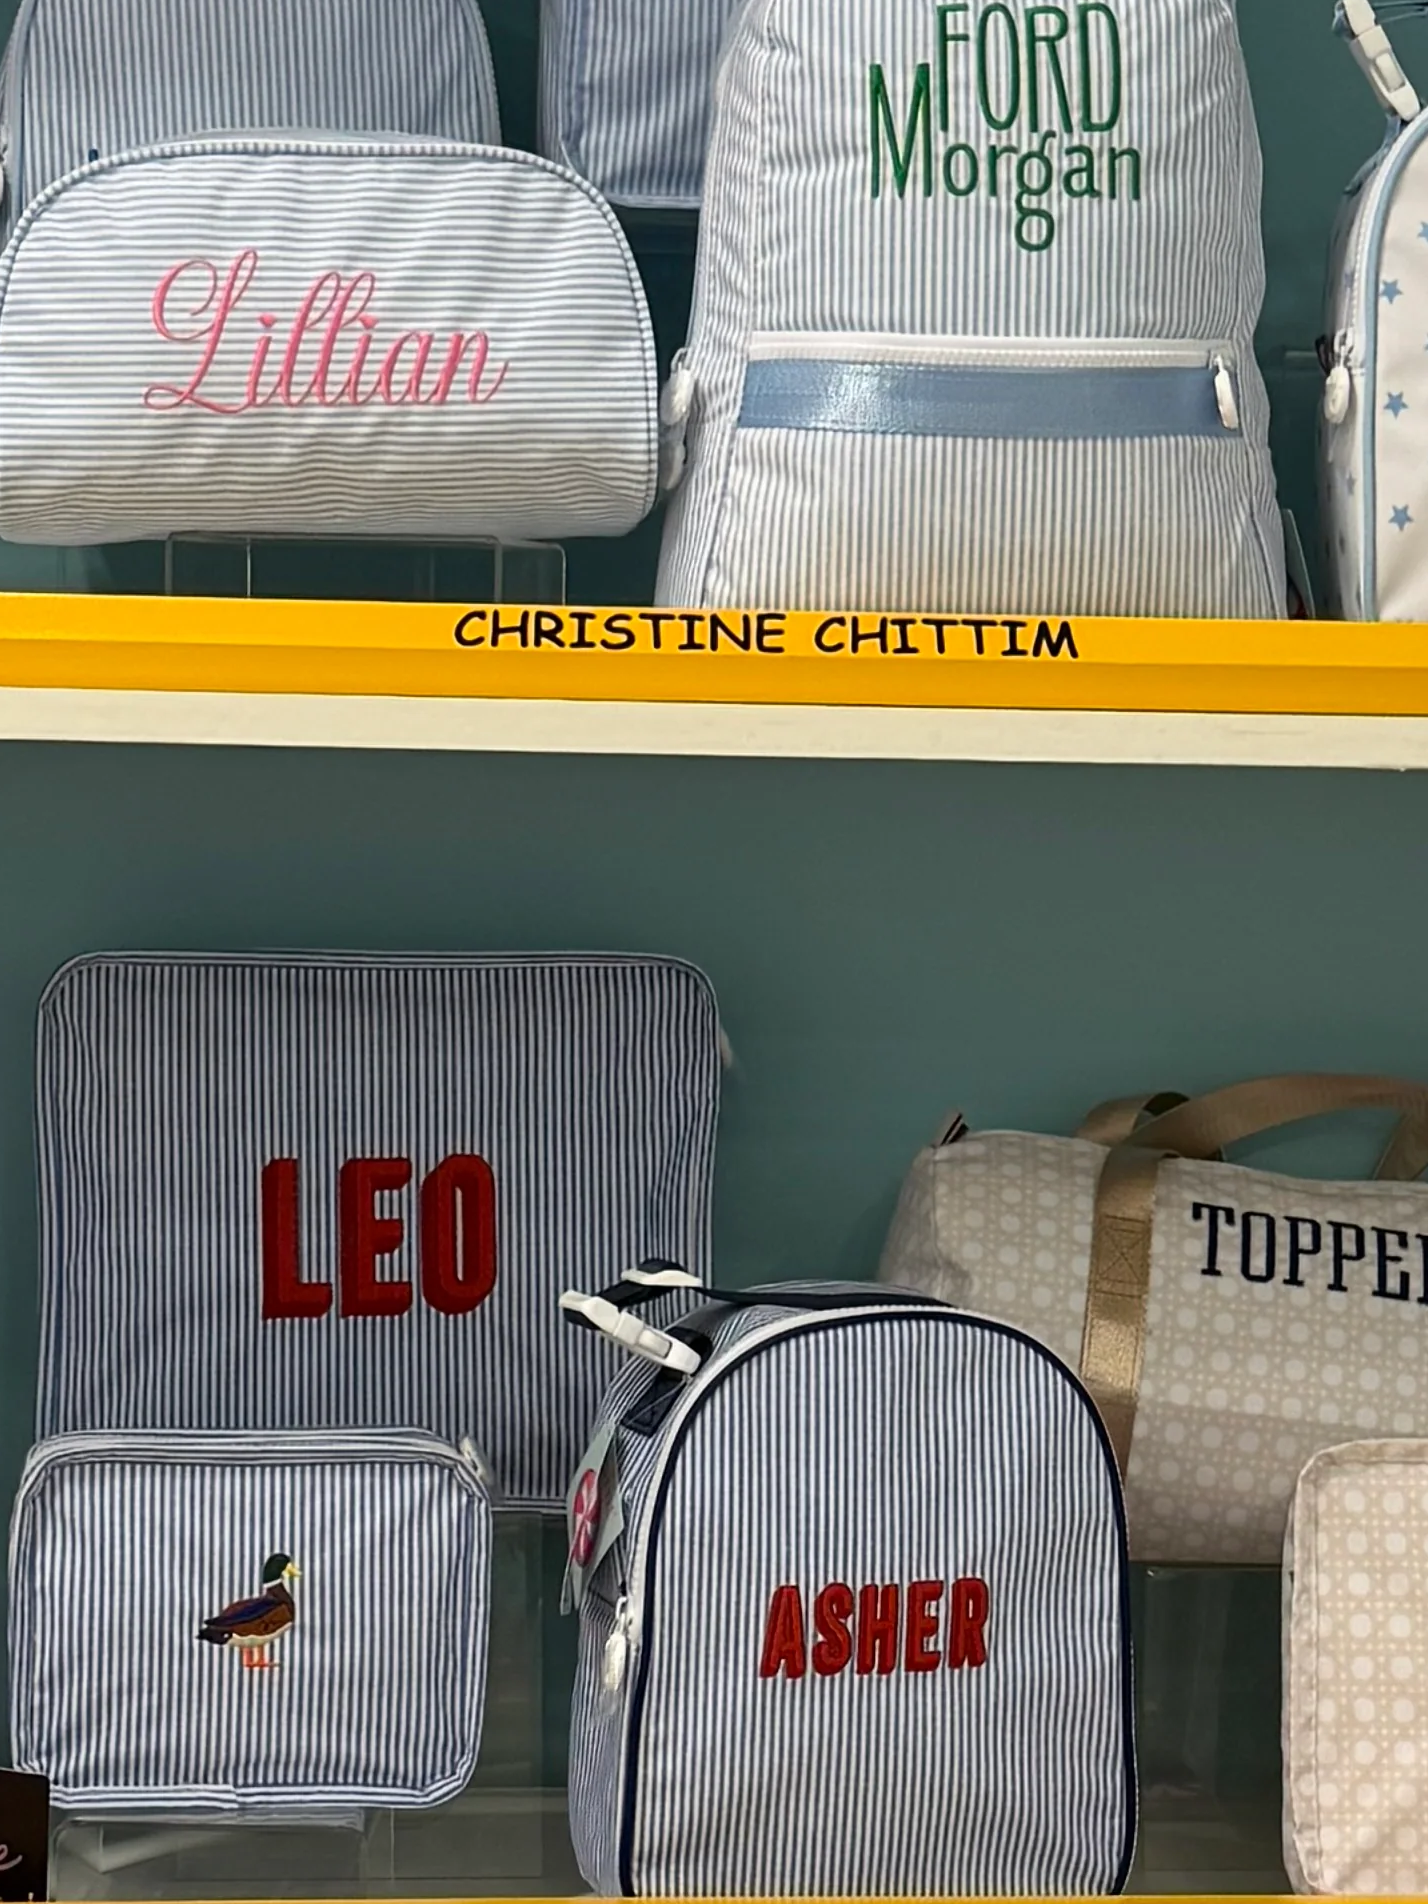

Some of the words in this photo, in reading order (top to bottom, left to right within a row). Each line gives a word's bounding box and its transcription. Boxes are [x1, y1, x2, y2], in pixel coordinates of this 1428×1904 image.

[936, 1, 1124, 134] FORD
[868, 61, 1143, 252] Morgan
[143, 248, 510, 417] Lillian
[453, 607, 787, 656] CHRISTINE
[814, 613, 1080, 661] CHITTIM
[260, 1152, 498, 1320] LEO
[760, 1576, 990, 1681] ASHER
